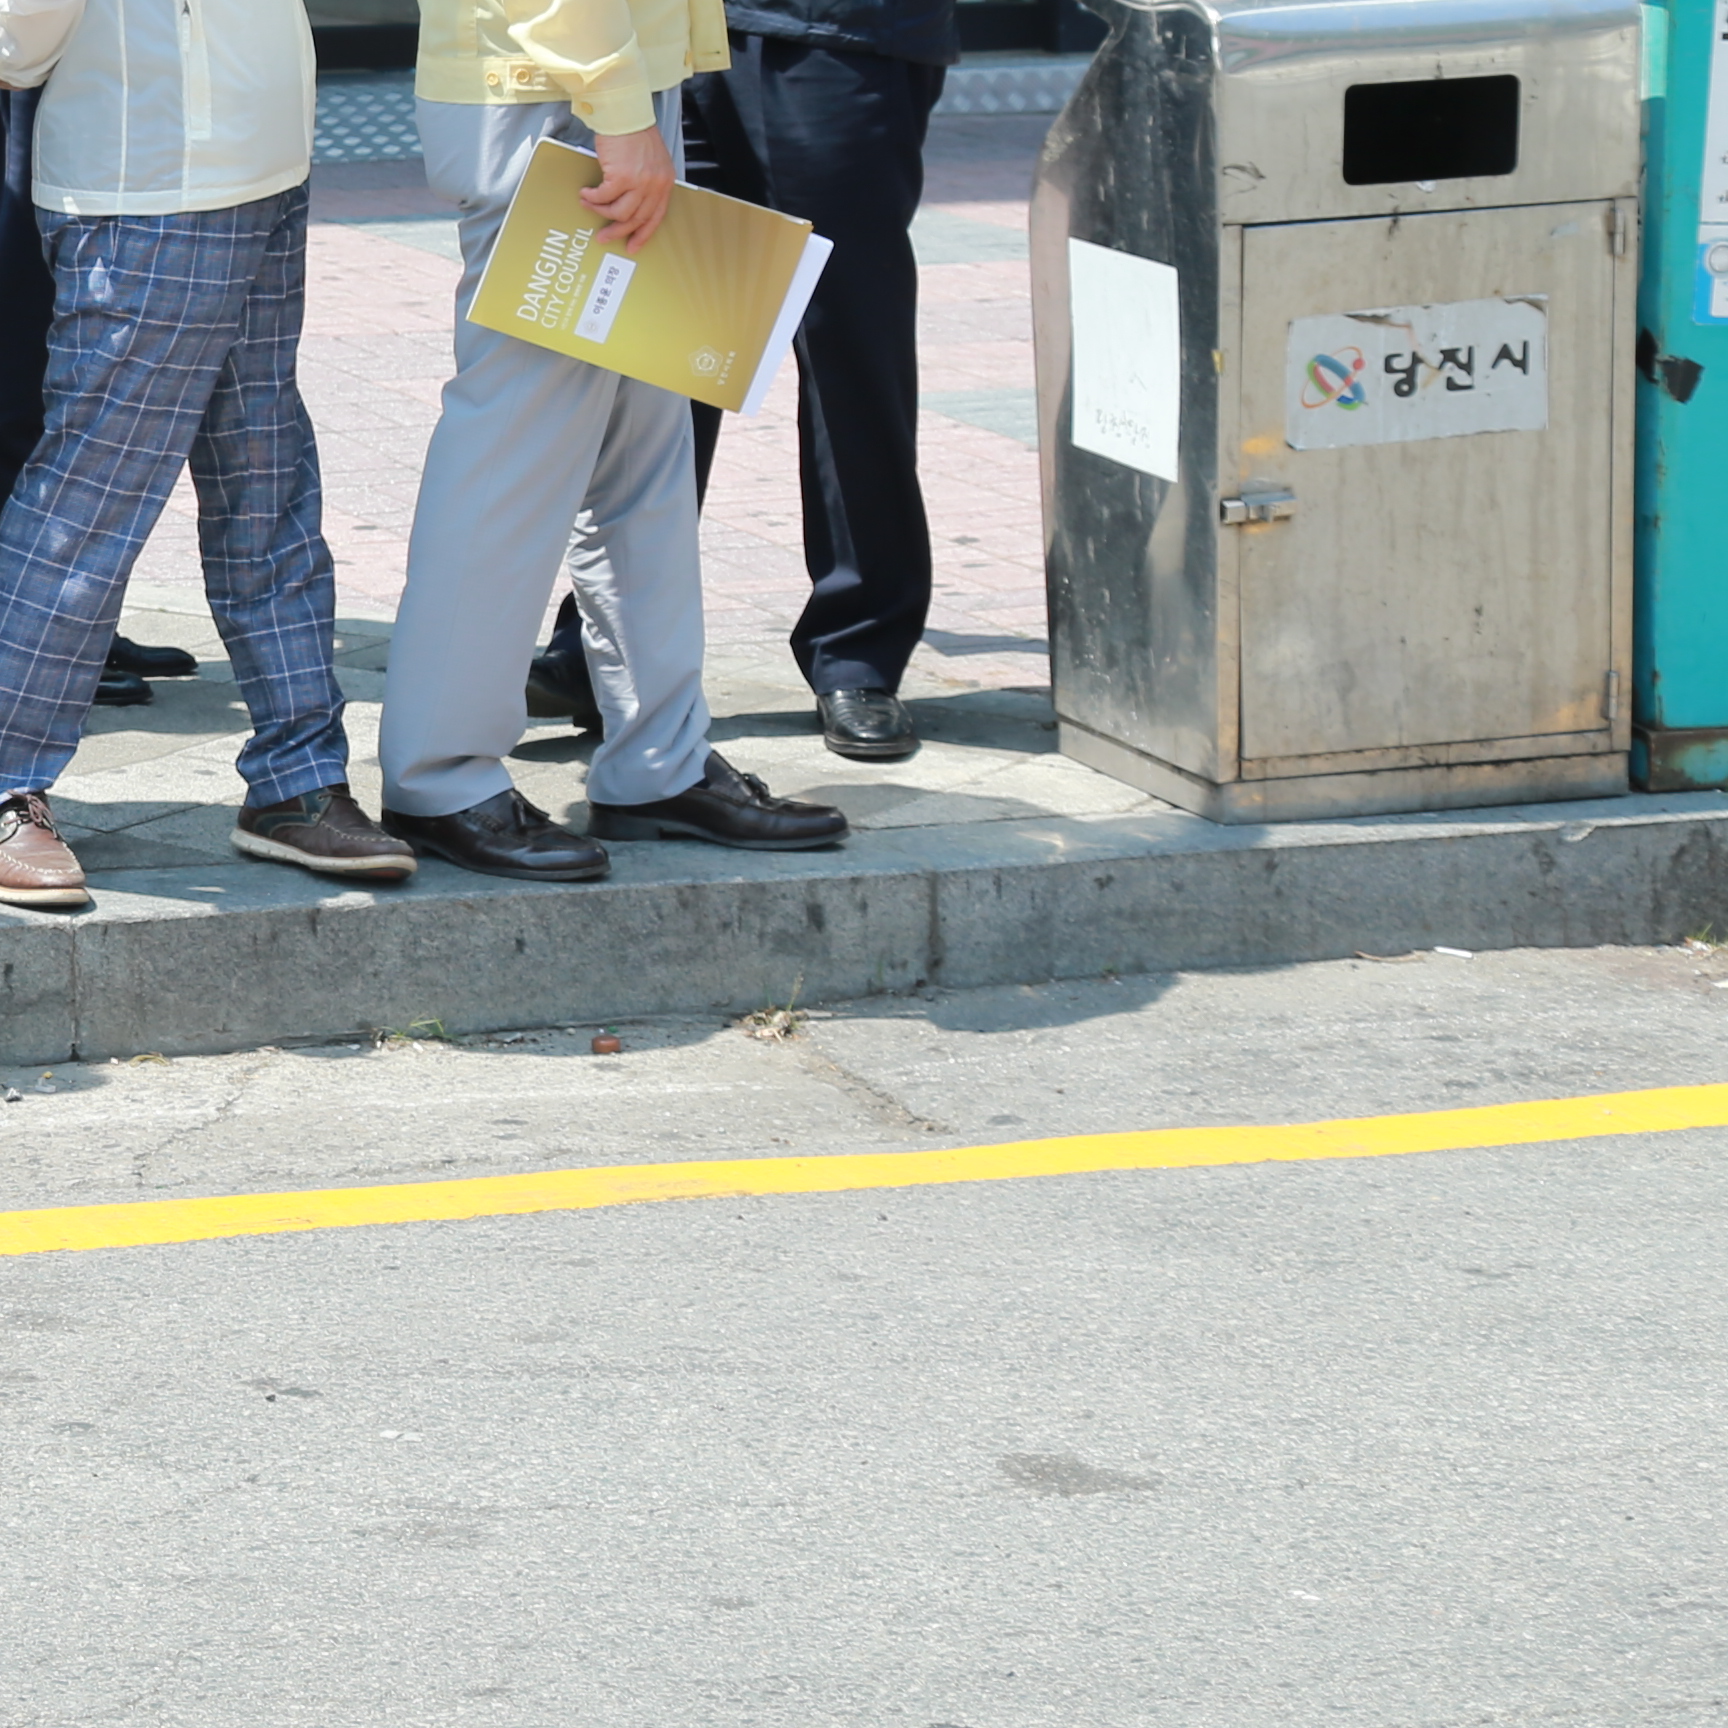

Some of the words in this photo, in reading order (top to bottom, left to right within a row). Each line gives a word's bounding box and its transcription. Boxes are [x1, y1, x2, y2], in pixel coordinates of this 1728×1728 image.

[516, 228, 570, 322] DANGJIN
[541, 294, 566, 330] CITY
[555, 226, 594, 295] COUNCIL
[1382, 336, 1532, 398] 당진시
